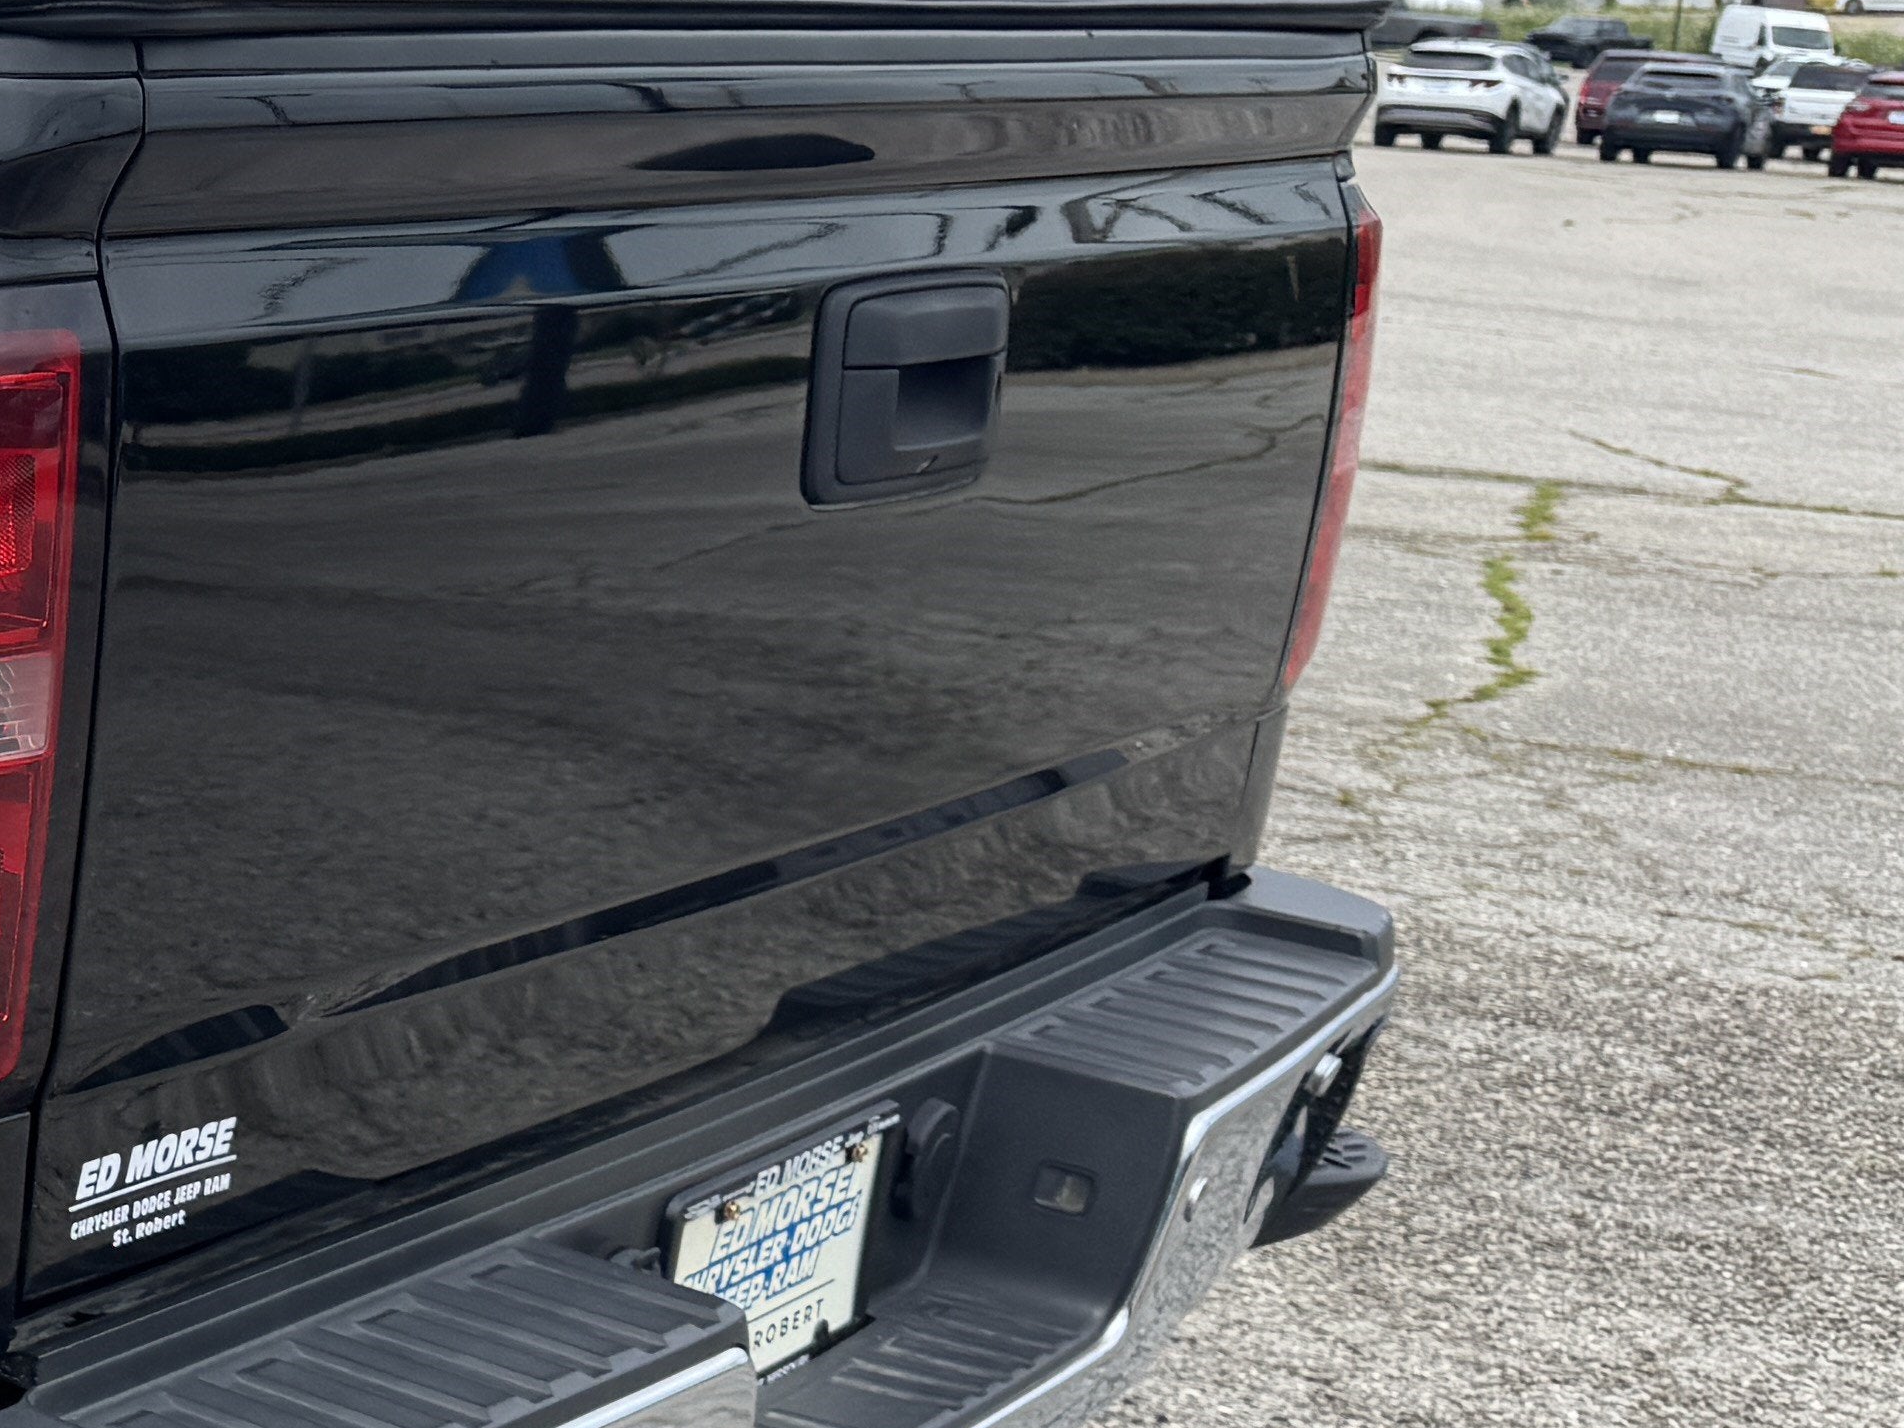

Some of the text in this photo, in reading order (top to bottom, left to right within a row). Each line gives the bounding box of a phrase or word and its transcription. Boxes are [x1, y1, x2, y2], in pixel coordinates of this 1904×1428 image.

[76, 1115, 238, 1201] ED MORSE
[69, 1172, 232, 1241] CHRYSLER DODGE JEEP RAM
[112, 1208, 187, 1248] St. Robert
[710, 1208, 755, 1263] ED
[750, 1161, 856, 1243] MORSE
[752, 1297, 825, 1349] ROBERT
